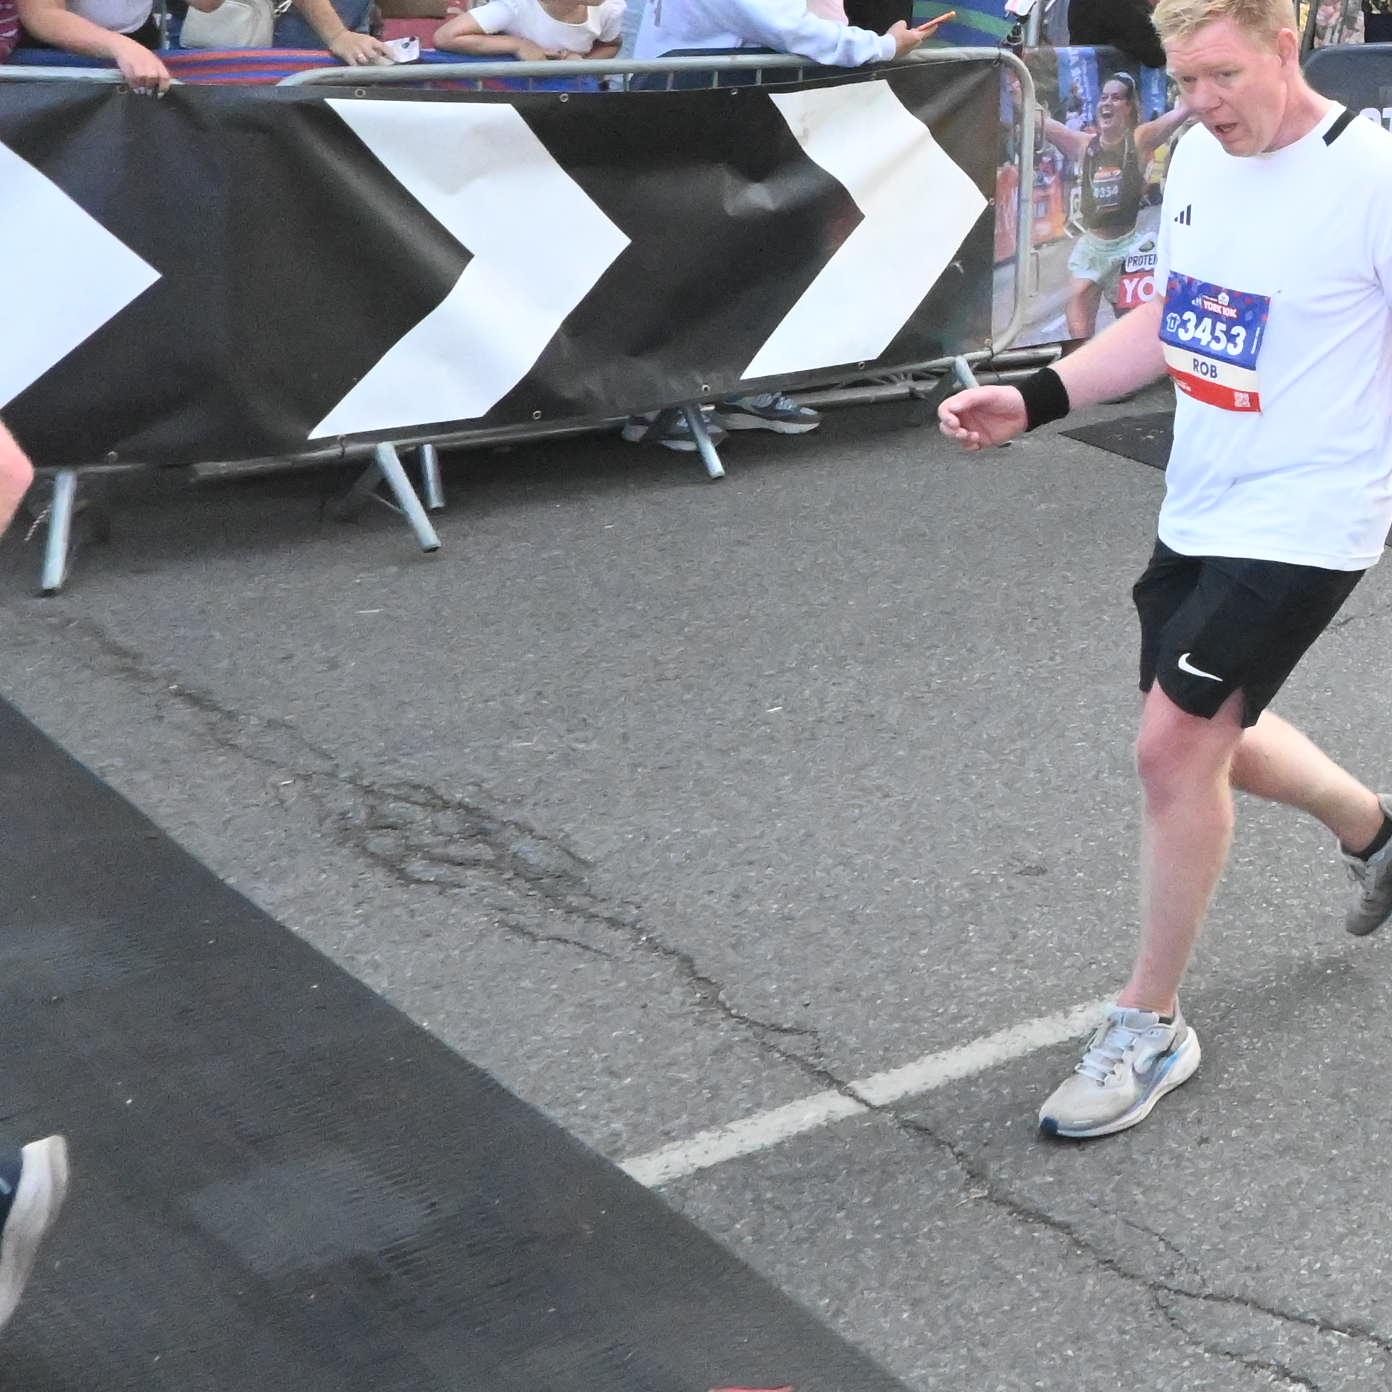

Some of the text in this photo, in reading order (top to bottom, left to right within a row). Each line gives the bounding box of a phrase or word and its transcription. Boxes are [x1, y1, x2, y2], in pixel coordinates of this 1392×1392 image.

[1128, 254, 1158, 267] PROTEI
[1123, 276, 1156, 303] YO
[1178, 311, 1246, 356] 3453
[1193, 358, 1218, 378] ROB
